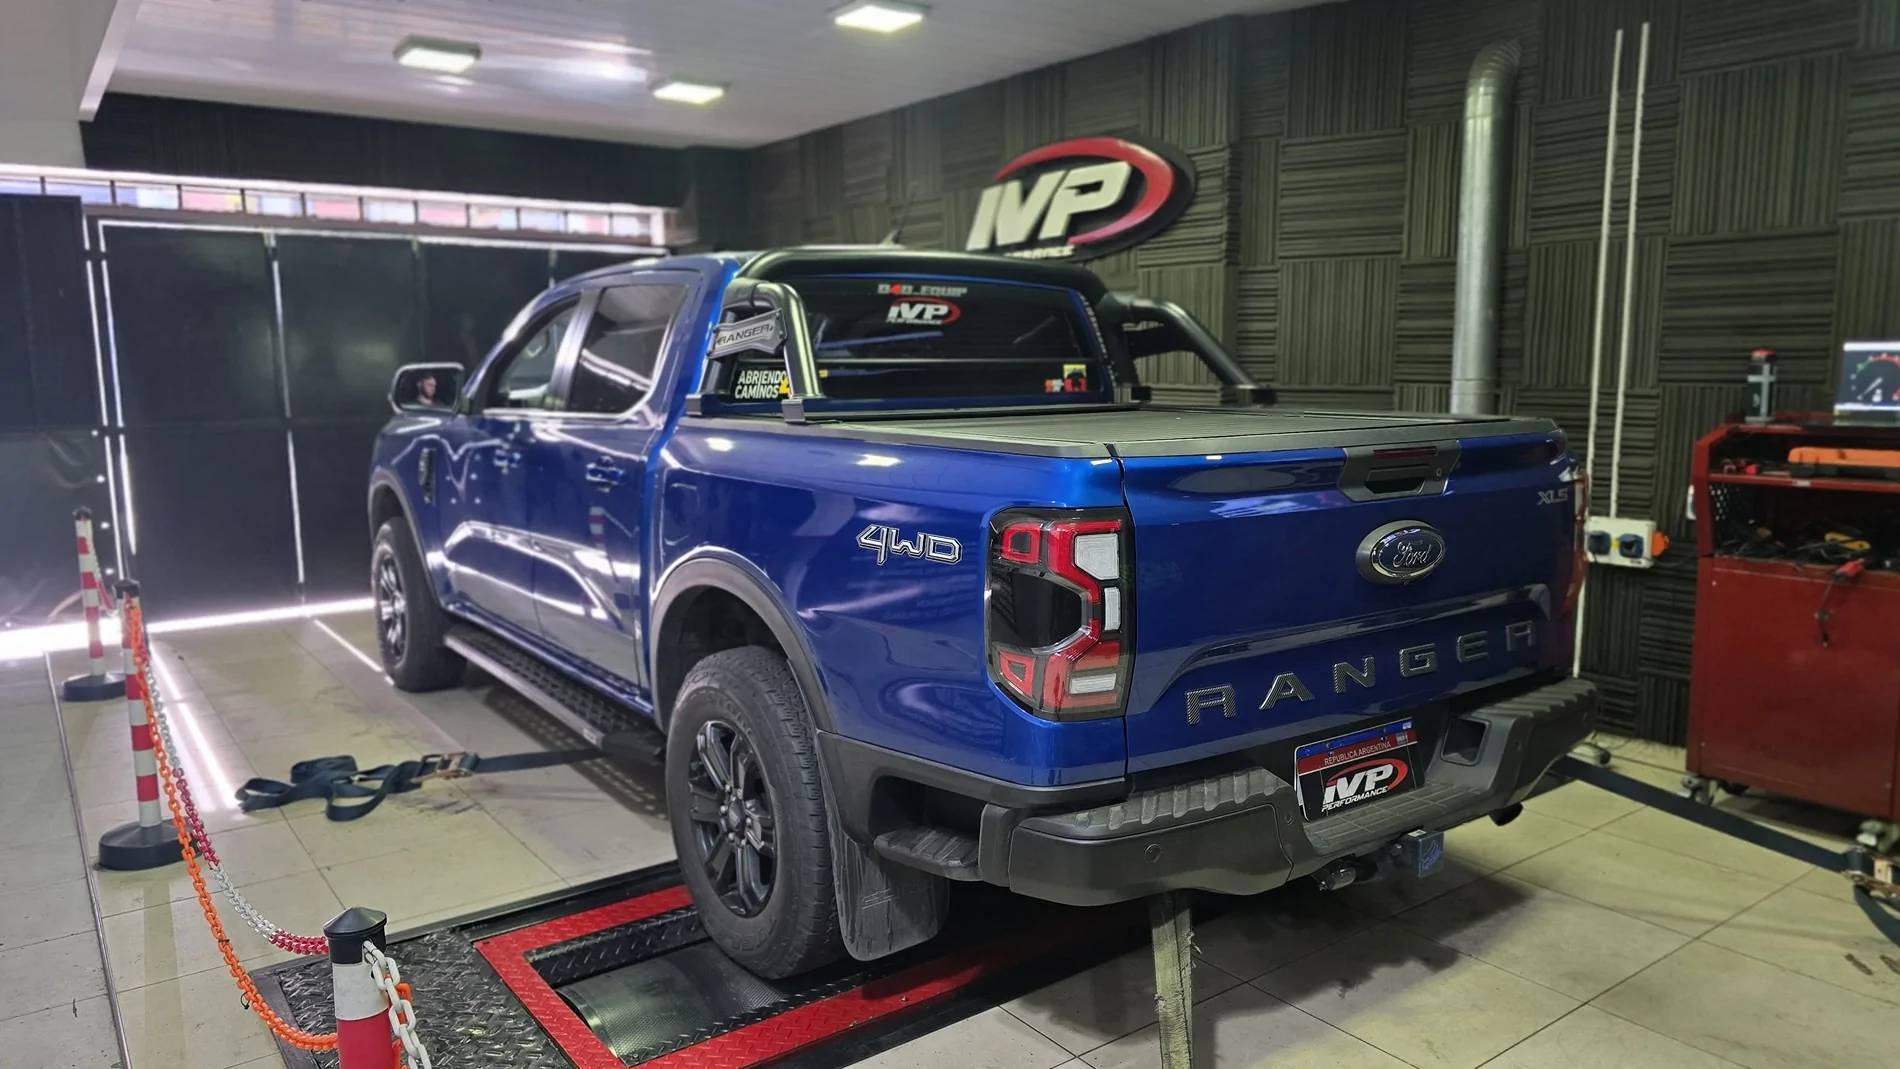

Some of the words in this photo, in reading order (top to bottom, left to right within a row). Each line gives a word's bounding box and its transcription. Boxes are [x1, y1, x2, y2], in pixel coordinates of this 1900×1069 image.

[717, 324, 772, 345] RANGER
[737, 370, 787, 386] ABRIENDO
[735, 384, 779, 399] CAMINOS
[856, 524, 963, 566] 4WD
[1393, 541, 1432, 568] Ford
[1185, 620, 1534, 725] RANGER
[1358, 741, 1391, 756] ARGENTINA
[1321, 785, 1388, 812] PERFORMANCE
